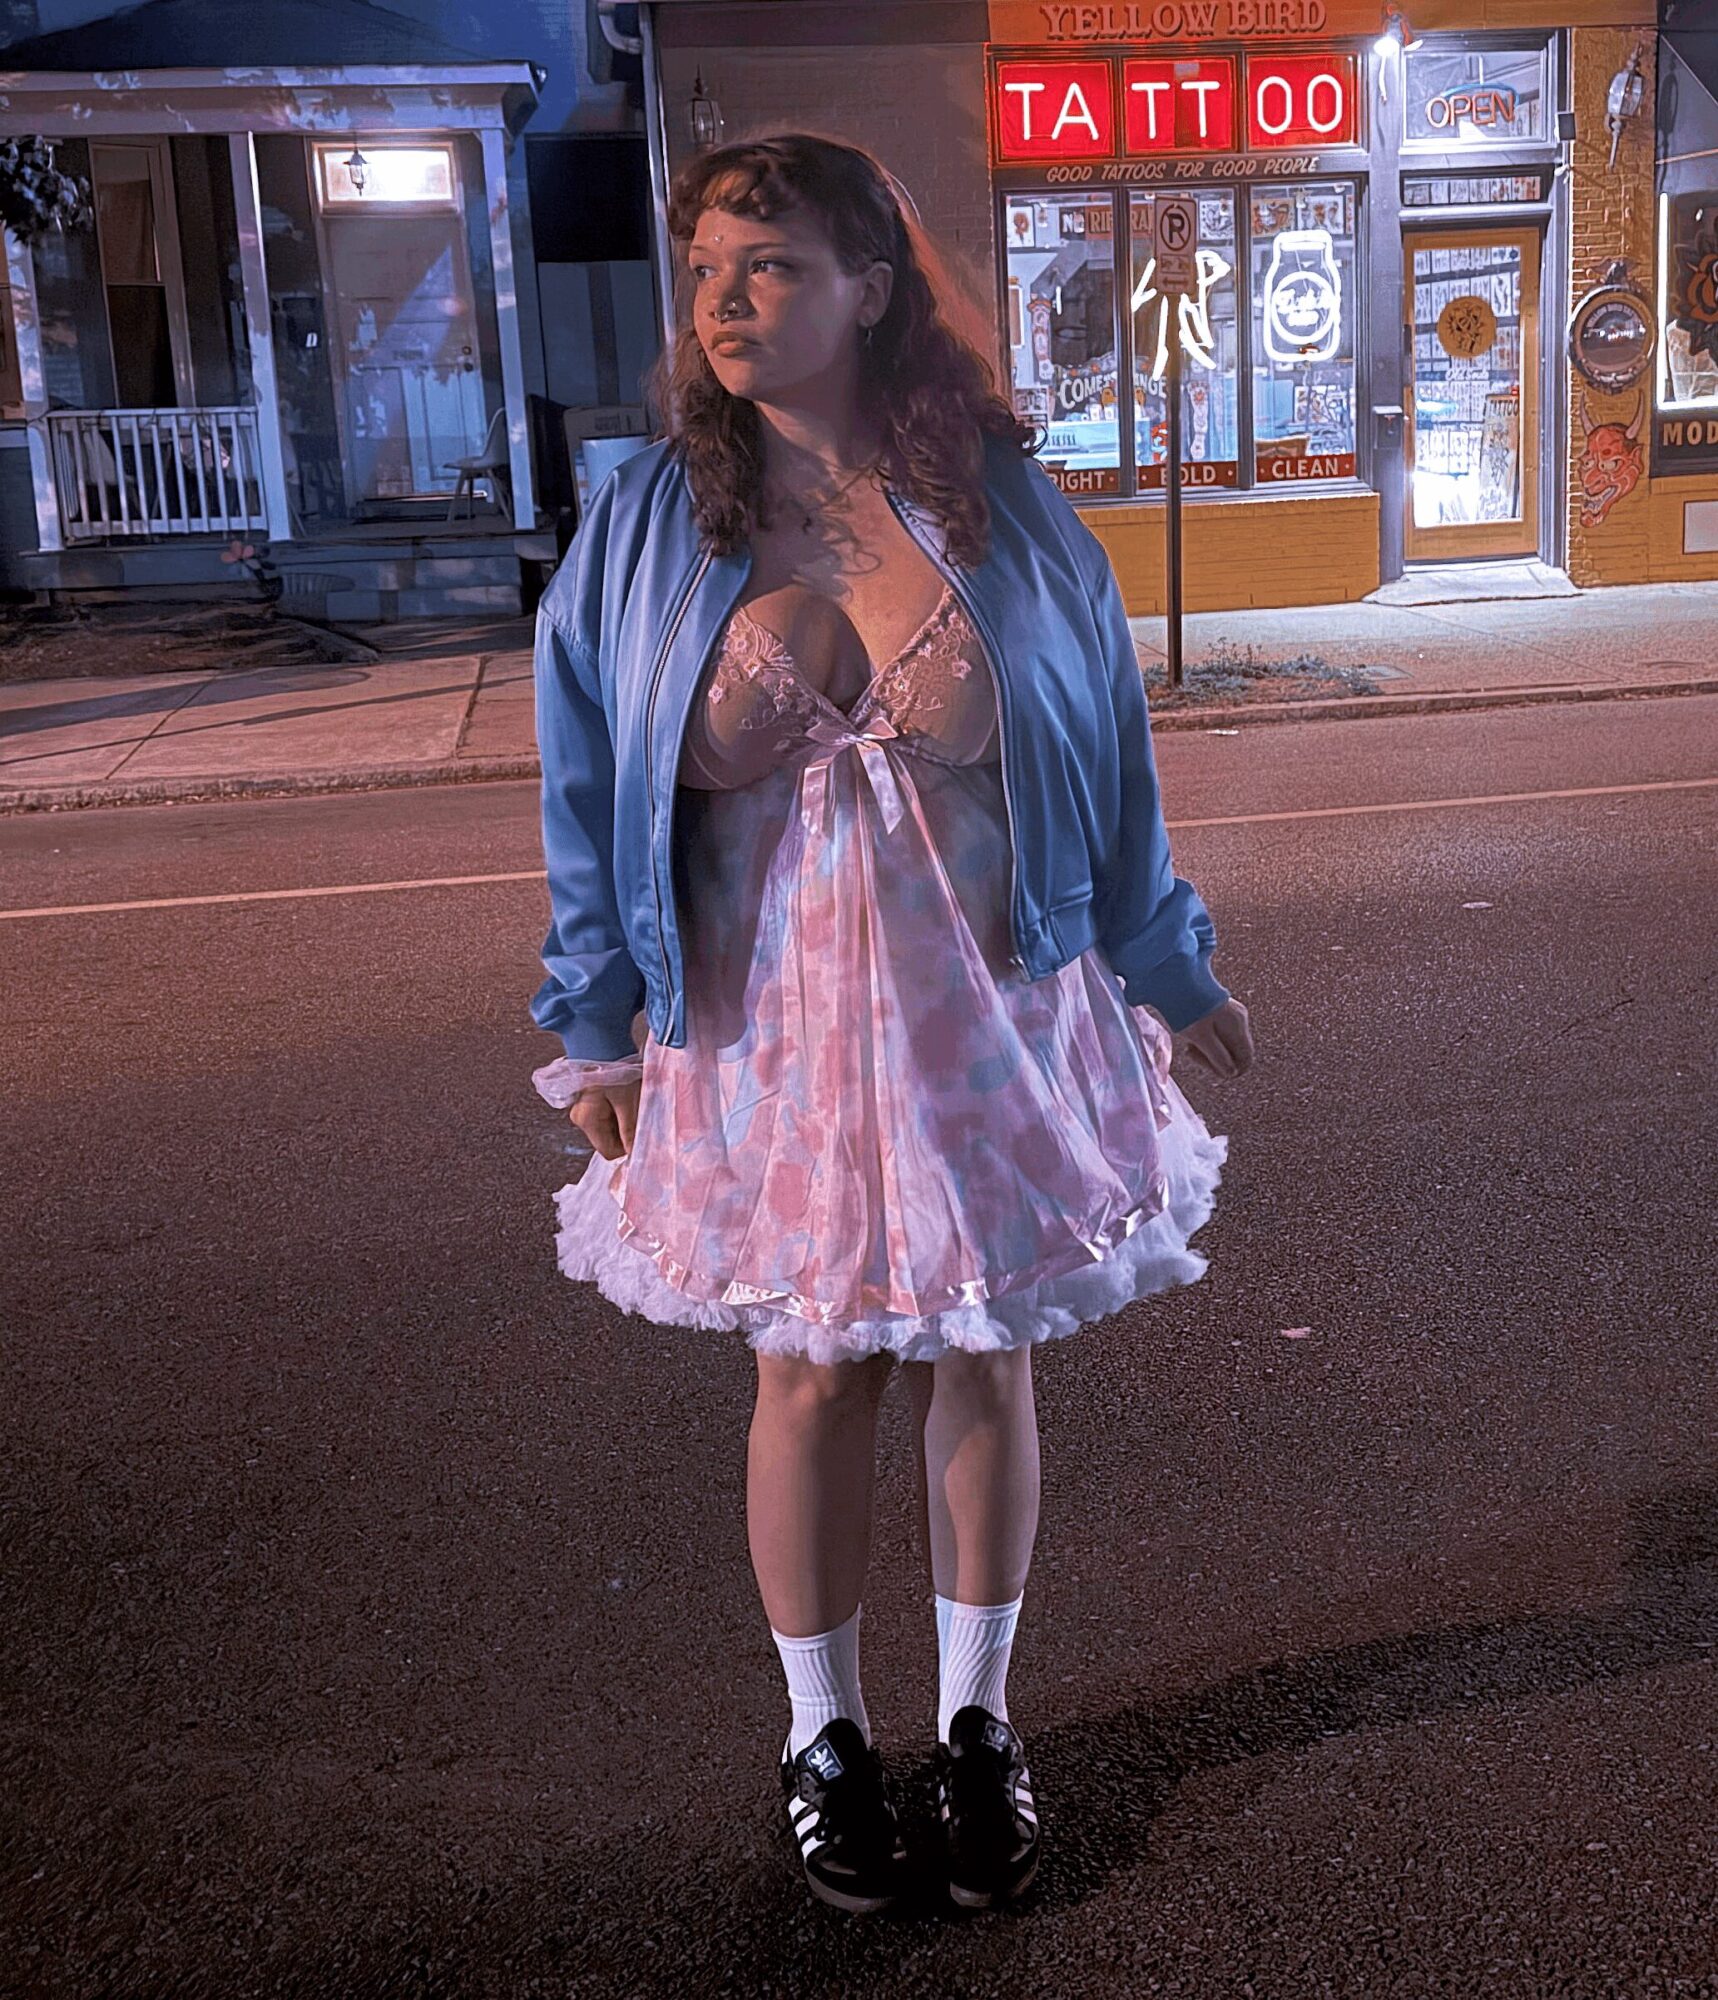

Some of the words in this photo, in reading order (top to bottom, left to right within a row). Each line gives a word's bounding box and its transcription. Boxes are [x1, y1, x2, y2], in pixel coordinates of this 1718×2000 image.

[1040, 2, 1218, 39] YELLOW
[1228, 0, 1327, 34] BIRD
[1005, 74, 1343, 141] TATTOO
[1425, 90, 1515, 128] OPEN
[1046, 166, 1094, 183] GOOD
[1100, 162, 1167, 181] TATTOOS
[1174, 161, 1206, 178] FOR
[1212, 160, 1257, 177] GOOD
[1263, 156, 1321, 175] PEOPLE
[1050, 471, 1105, 491] RIGHT
[1272, 458, 1339, 478] CLEAN
